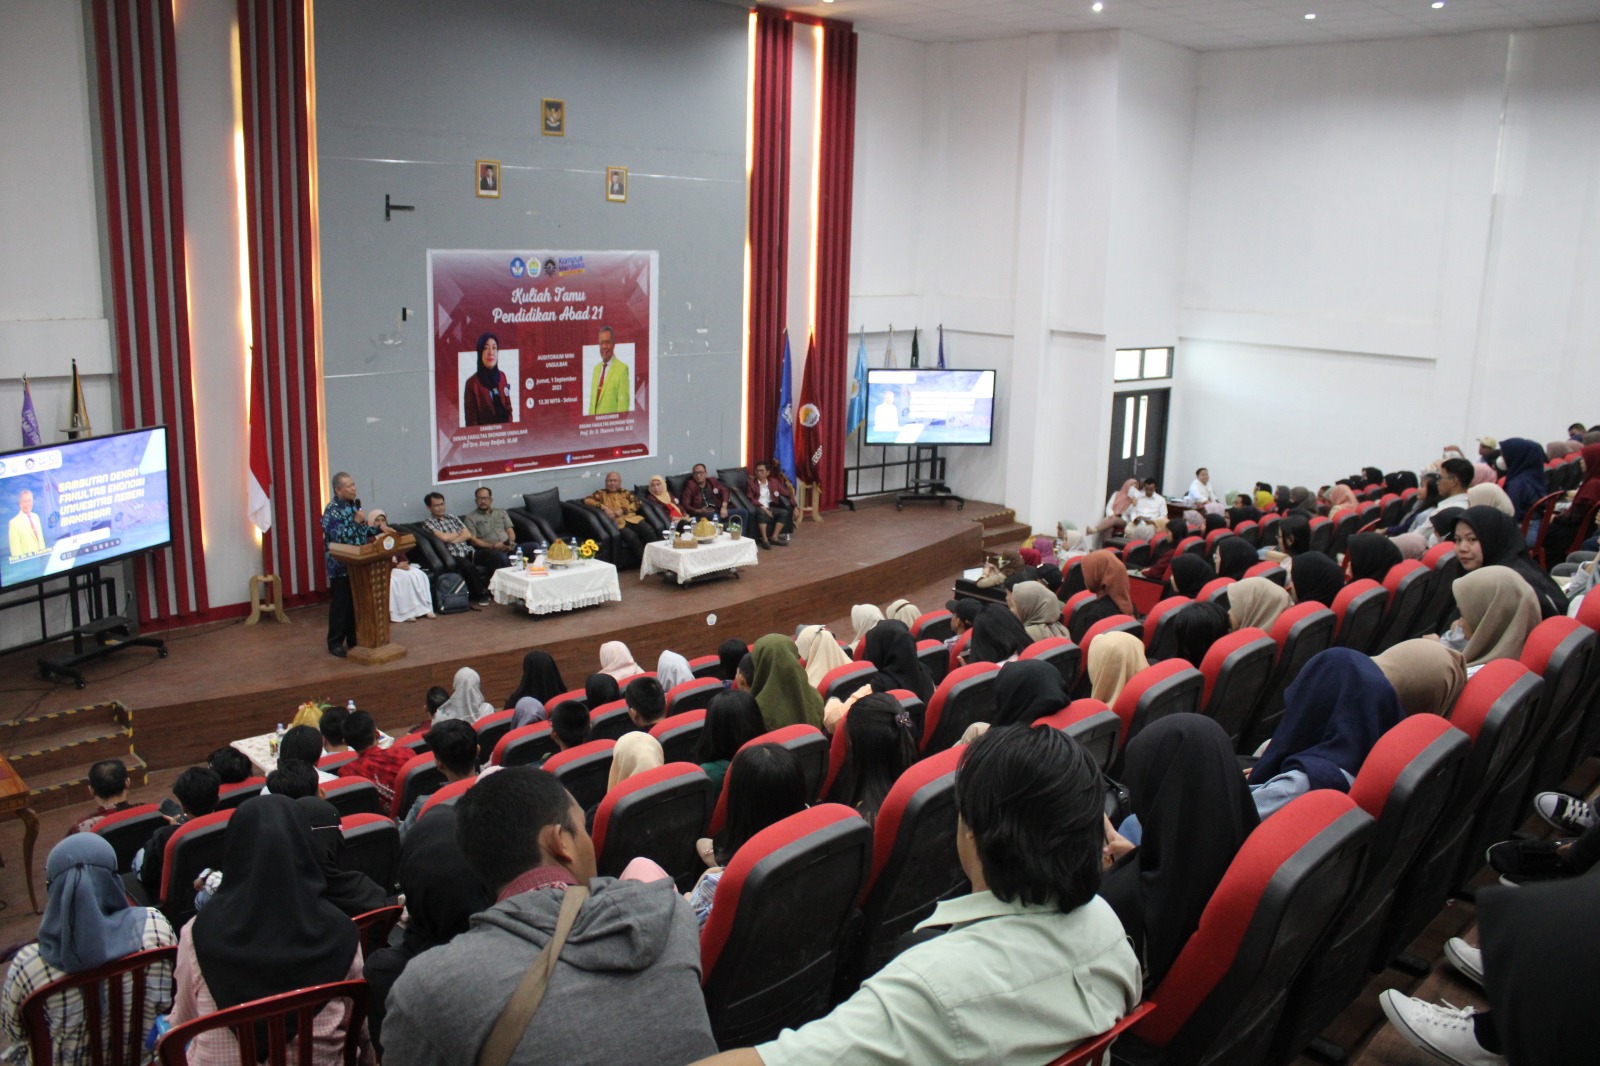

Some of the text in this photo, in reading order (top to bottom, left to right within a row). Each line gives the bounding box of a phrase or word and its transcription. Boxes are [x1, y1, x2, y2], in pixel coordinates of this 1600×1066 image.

[511, 286, 586, 304] Kuliah Tamu
[492, 305, 604, 323] Pendidikan Abad 21
[467, 433, 488, 441] FAKULTAS
[58, 467, 139, 492] SAMBUTAN DEKAN
[59, 476, 146, 504] FAKULTAS EKONOMI
[114, 488, 145, 503] NEGERI
[61, 507, 112, 527] MAKASSAR
